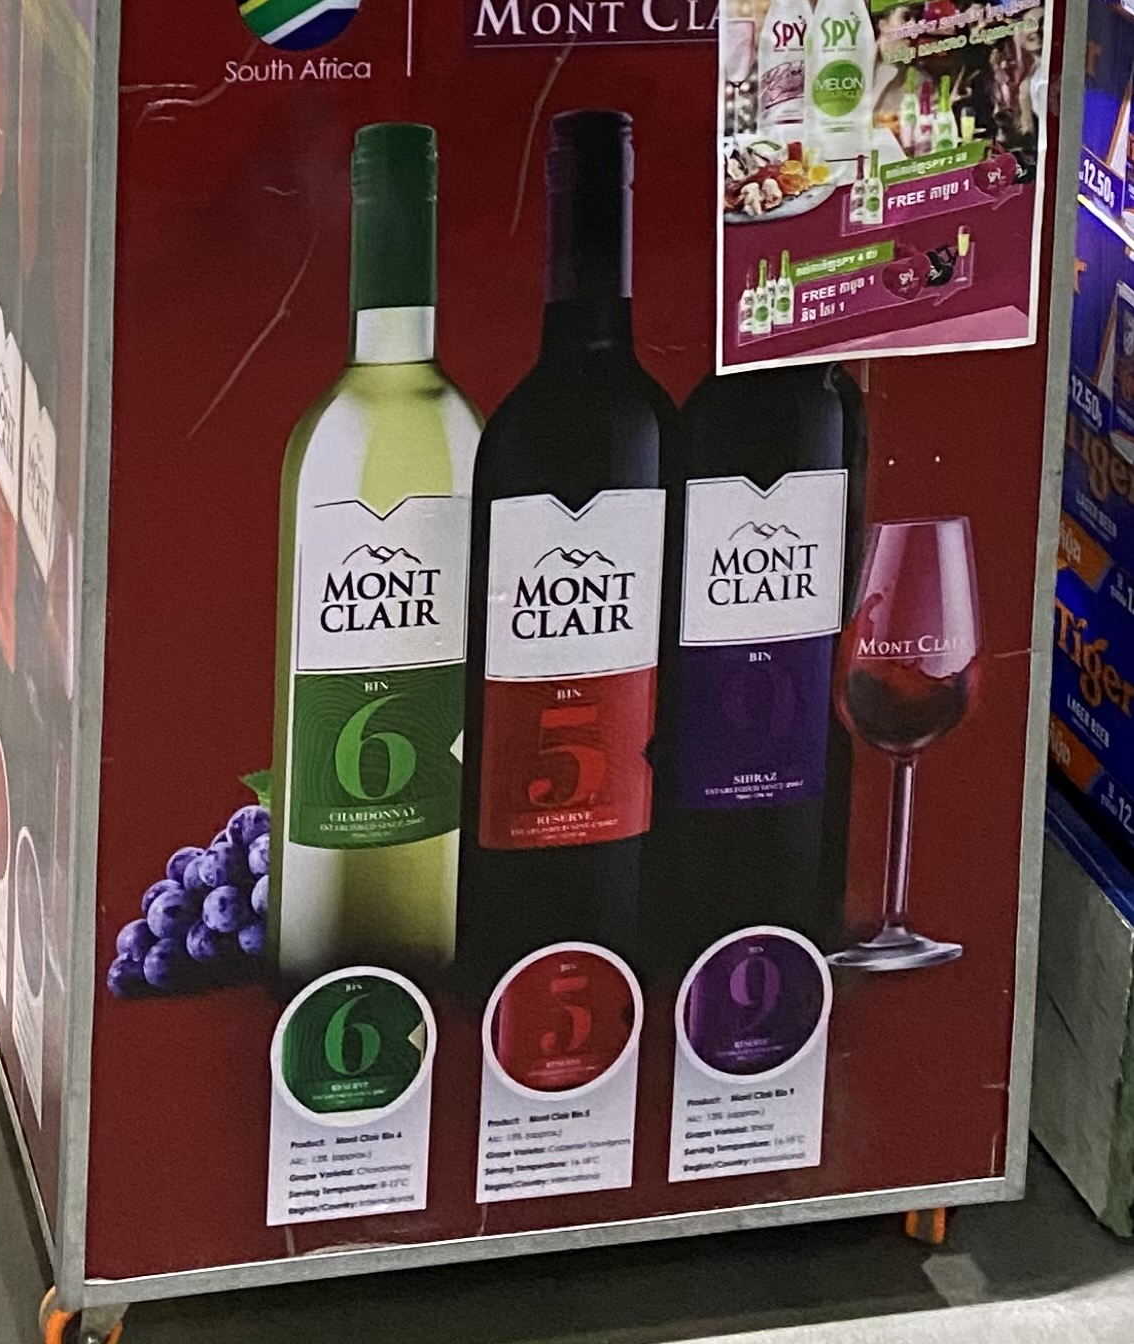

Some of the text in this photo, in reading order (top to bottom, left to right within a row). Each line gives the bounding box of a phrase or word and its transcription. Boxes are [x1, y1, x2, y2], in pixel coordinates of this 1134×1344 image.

[773, 19, 808, 47] SPY
[821, 15, 861, 47] SPY
[224, 58, 371, 83] South Africa
[816, 77, 864, 92] MELON
[887, 190, 926, 210] FREE
[962, 179, 970, 192] 1
[801, 285, 837, 304] FREE
[868, 275, 875, 286] 1
[710, 544, 819, 577] MONT
[322, 569, 441, 604] MONT
[513, 572, 635, 608] MONT
[708, 573, 818, 606] CLAIR
[320, 599, 440, 633] CLAIR
[511, 604, 633, 640] CLAIR
[749, 652, 772, 662] BIN
[364, 681, 389, 692] BIN
[557, 689, 582, 700] BIN
[335, 694, 416, 800] 6
[527, 704, 606, 808] 5
[733, 771, 777, 785] SHIRAZ
[536, 812, 593, 826] RESERVE
[729, 956, 780, 1030] 9
[540, 975, 592, 1055] 5
[325, 993, 381, 1076] 6
